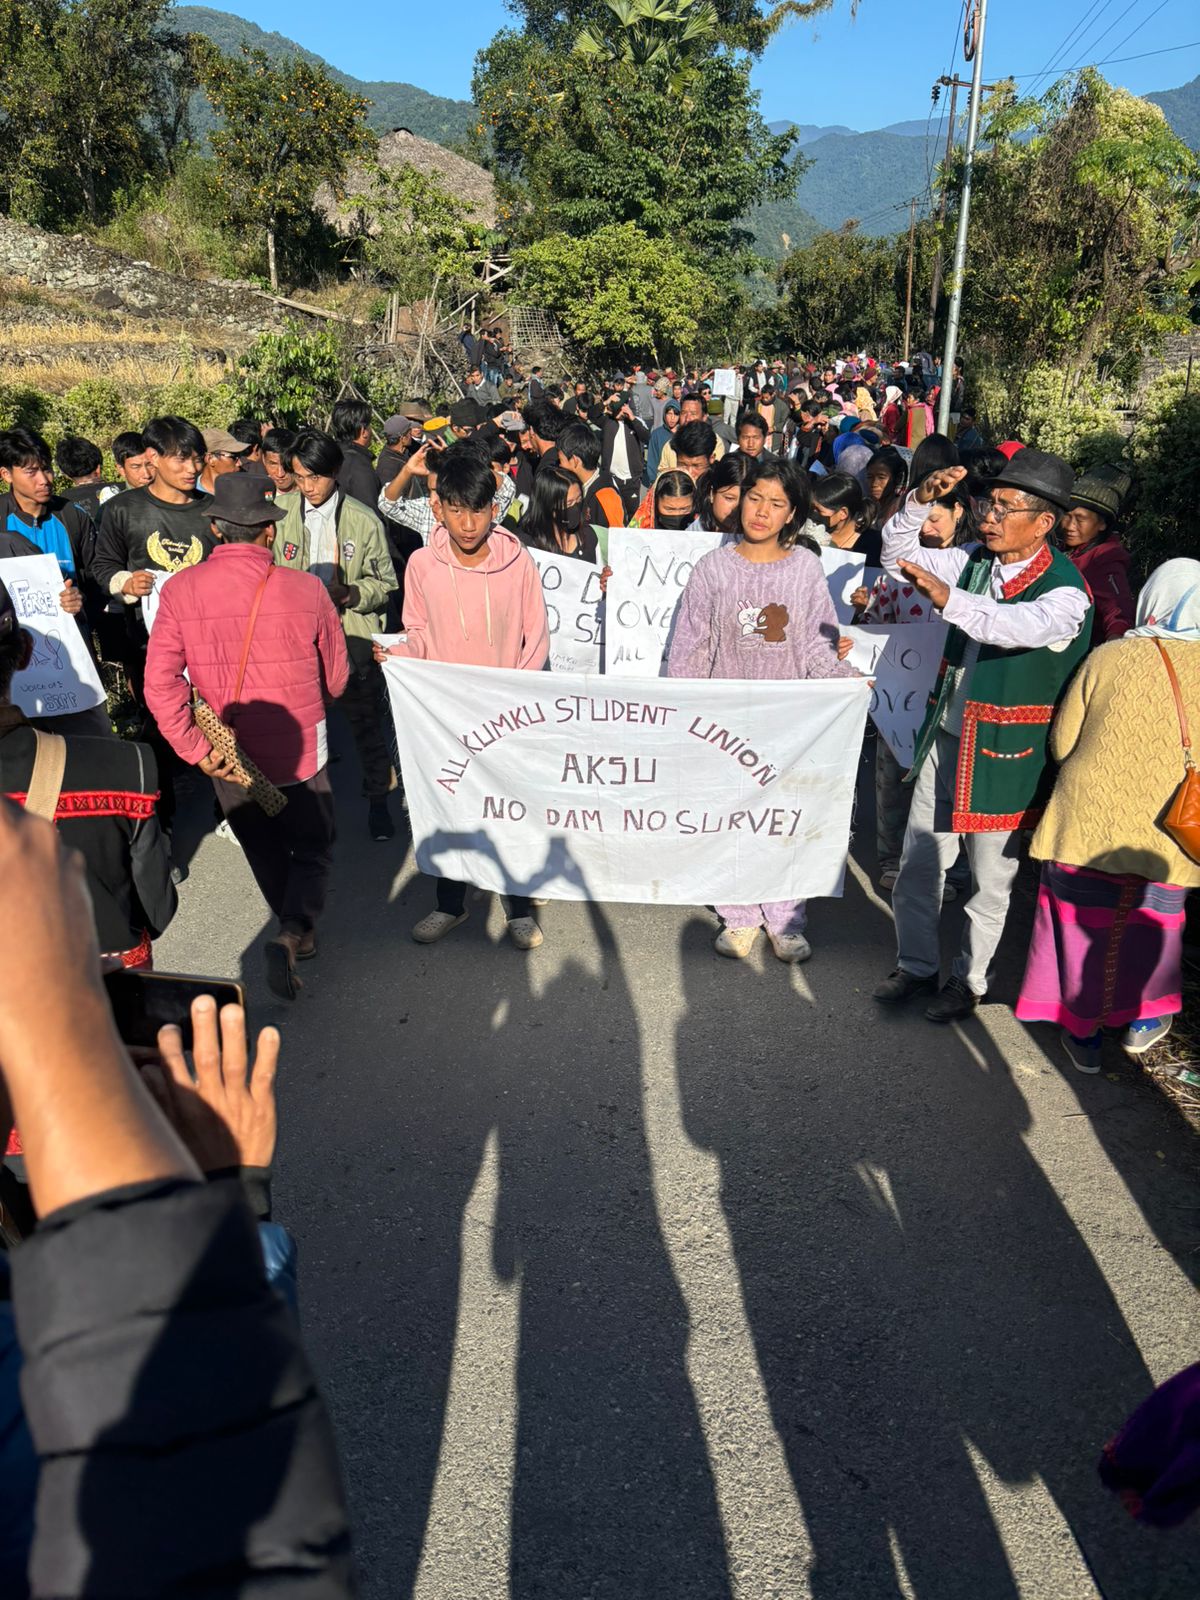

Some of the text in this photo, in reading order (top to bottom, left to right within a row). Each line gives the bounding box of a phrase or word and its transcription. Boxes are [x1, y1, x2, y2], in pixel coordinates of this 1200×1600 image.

[870, 642, 922, 671] NO
[436, 758, 469, 794] ALL
[456, 701, 546, 758] KUMKU
[555, 695, 678, 726] STUDENT
[561, 752, 658, 785] AKSU
[483, 796, 803, 837] NO DAM NO SURVEY
